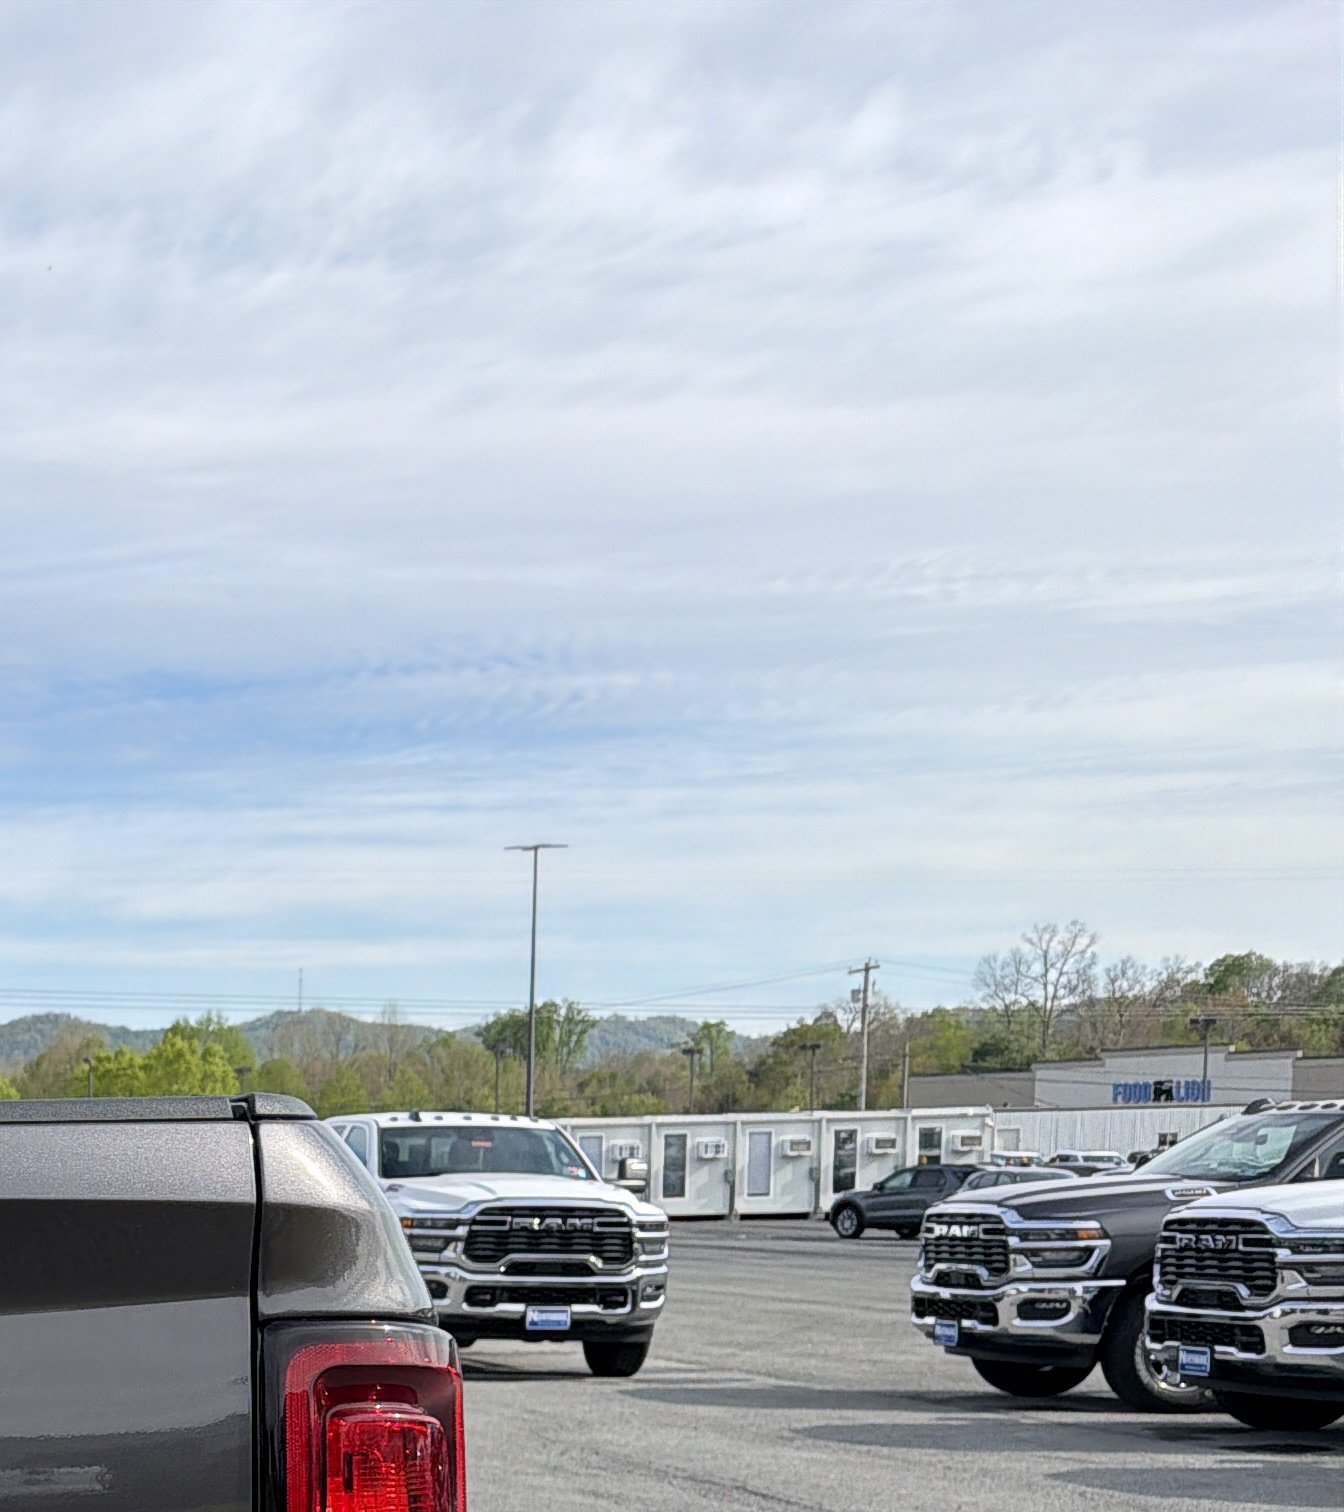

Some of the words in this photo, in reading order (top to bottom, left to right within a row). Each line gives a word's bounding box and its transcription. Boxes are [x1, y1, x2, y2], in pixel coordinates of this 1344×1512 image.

[1112, 1082, 1152, 1104] FOOD
[512, 1217, 593, 1231] RAM
[934, 1224, 979, 1238] RAM
[1179, 1233, 1237, 1250] RAM
